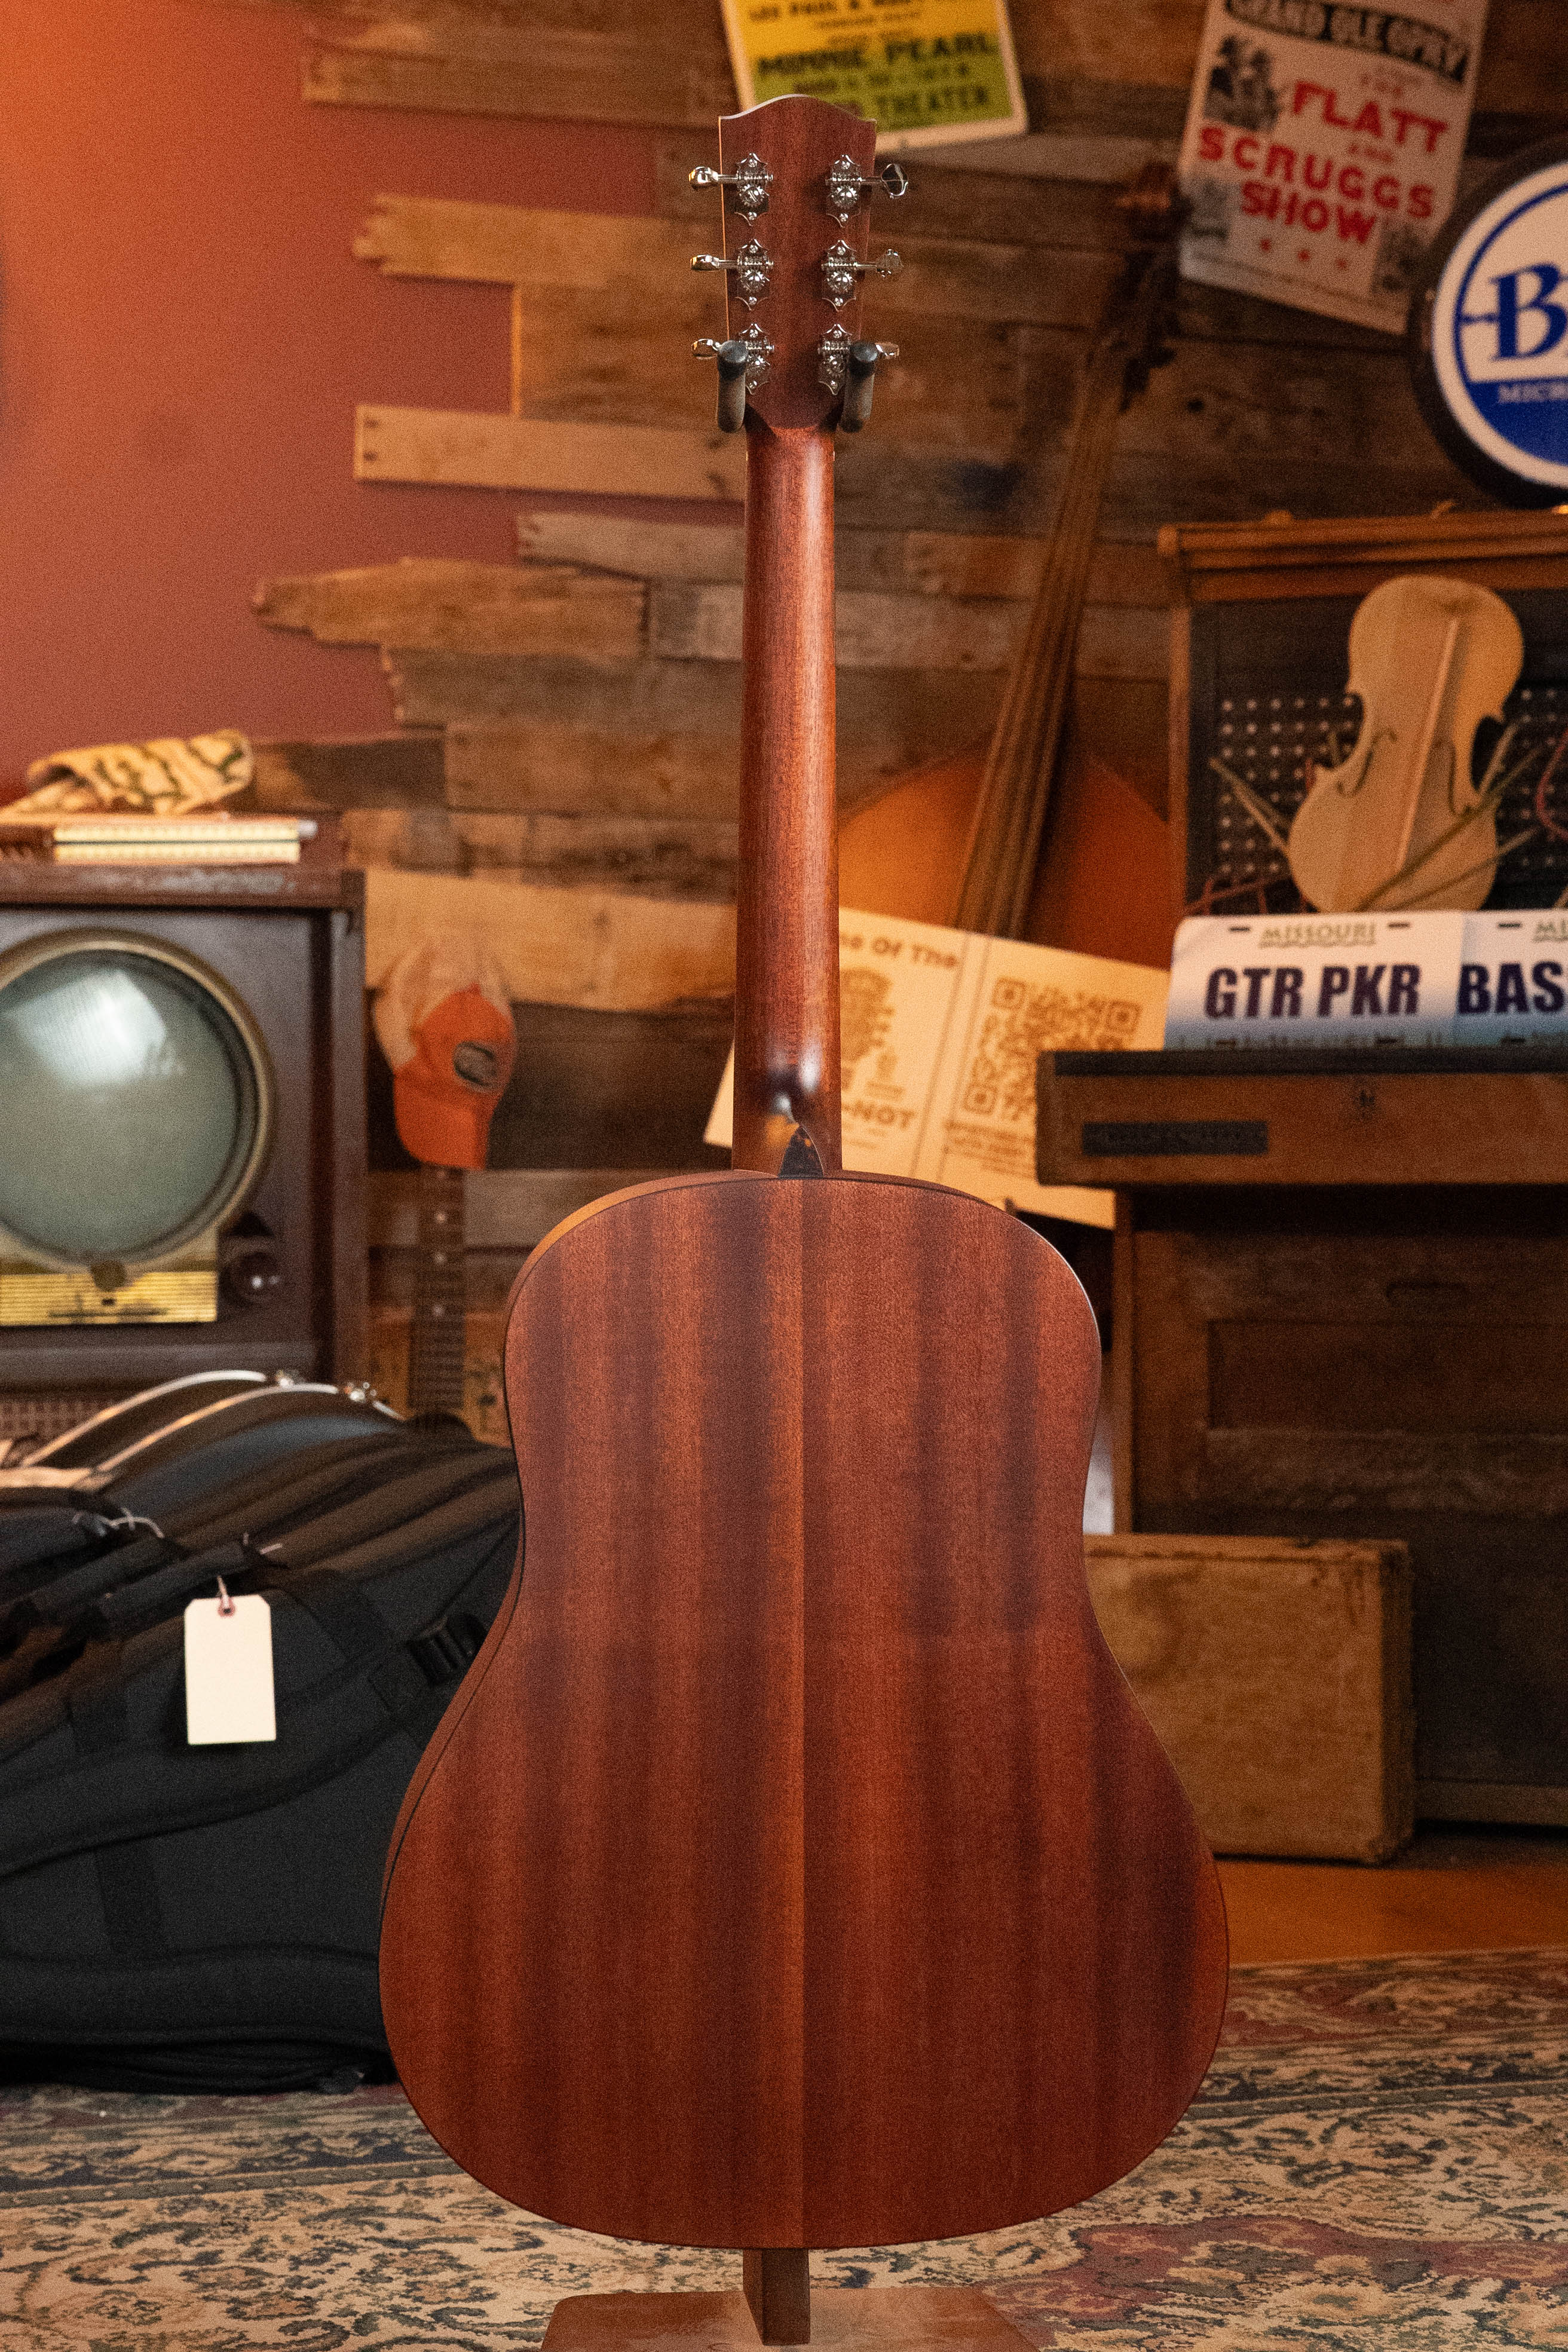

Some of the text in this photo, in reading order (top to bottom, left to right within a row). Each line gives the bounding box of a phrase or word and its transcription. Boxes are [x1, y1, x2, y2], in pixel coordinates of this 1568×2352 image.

[884, 32, 997, 65] PEARL
[1291, 79, 1448, 154] FLATT
[1198, 124, 1434, 219] SCRUGGS
[1241, 180, 1377, 244] SHOW
[1260, 921, 1376, 945] MISSOURI
[1203, 963, 1422, 1019] GTR PKR
[1457, 961, 1566, 1015] BAS
